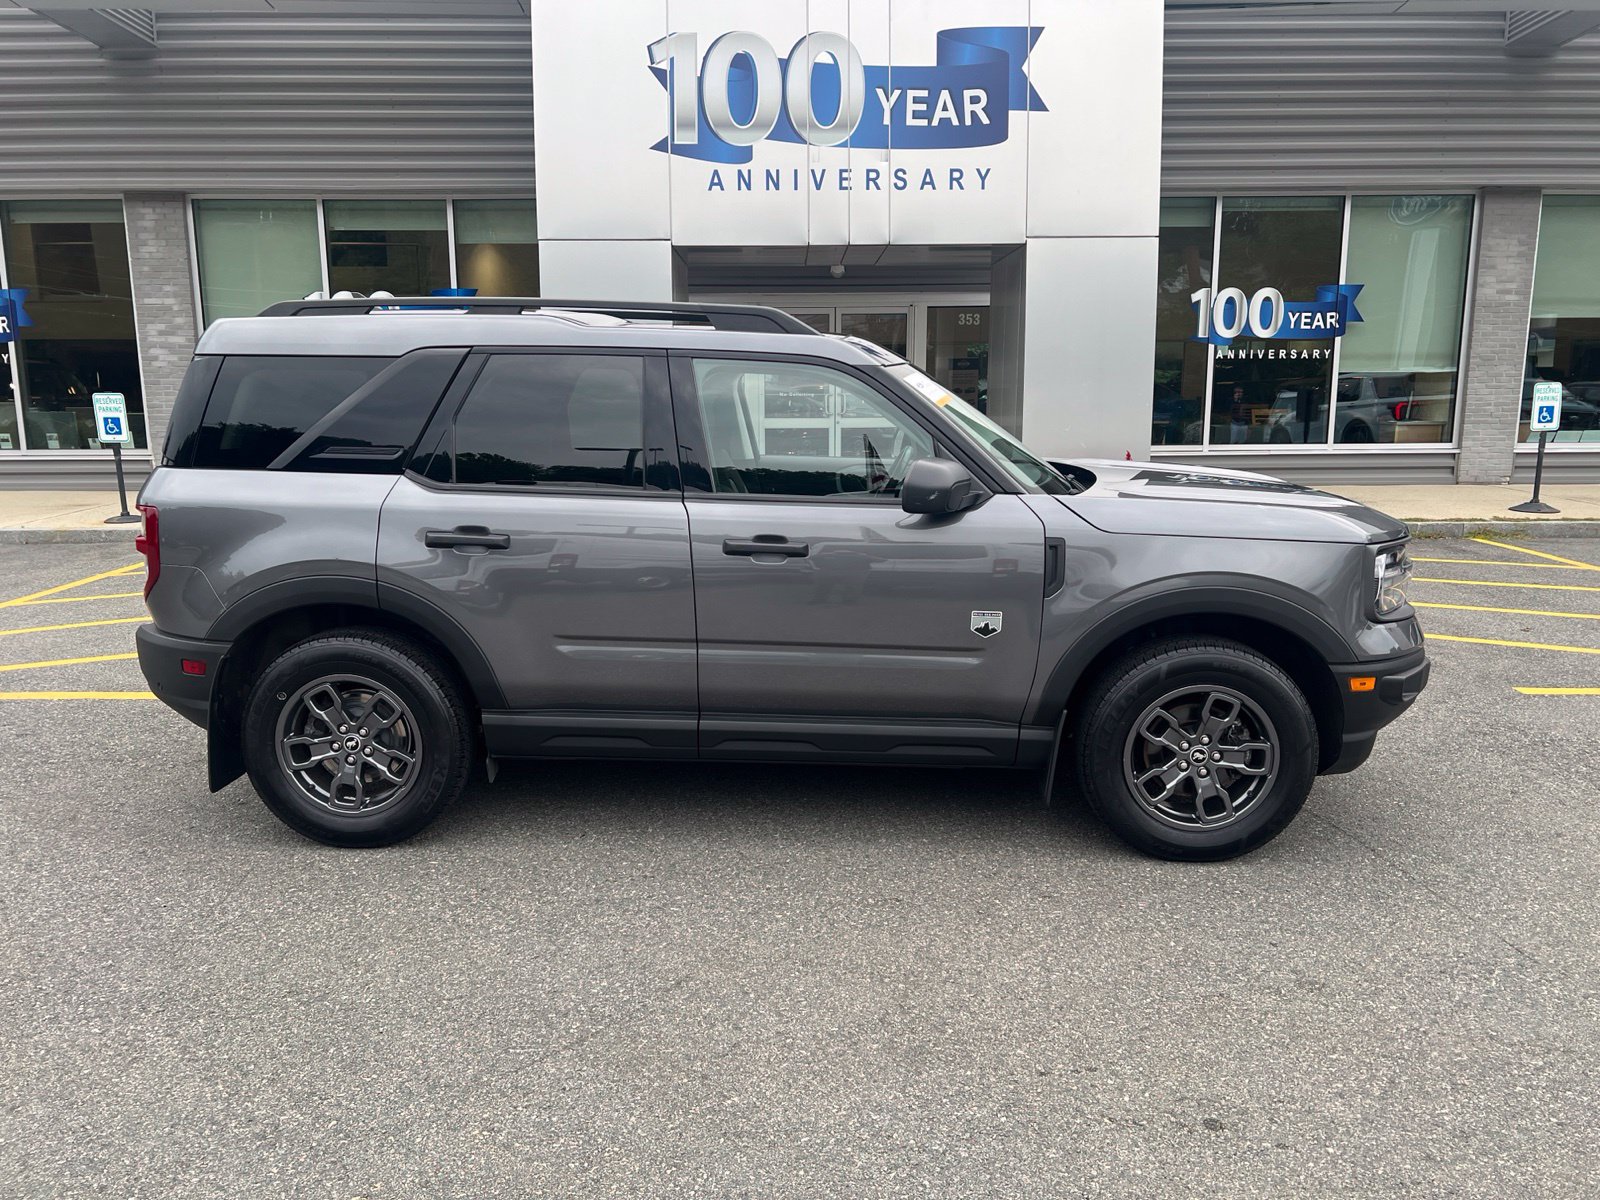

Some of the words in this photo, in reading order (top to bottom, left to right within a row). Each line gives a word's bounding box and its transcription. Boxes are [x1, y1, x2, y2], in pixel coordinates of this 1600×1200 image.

[647, 31, 866, 147] 100
[876, 88, 990, 126] YEAR
[708, 168, 992, 192] ANNIVERSARY
[958, 313, 980, 326] 353
[1191, 287, 1284, 338] 100
[1288, 311, 1340, 330] YEAR
[1216, 349, 1332, 360] ANNIVERSARY
